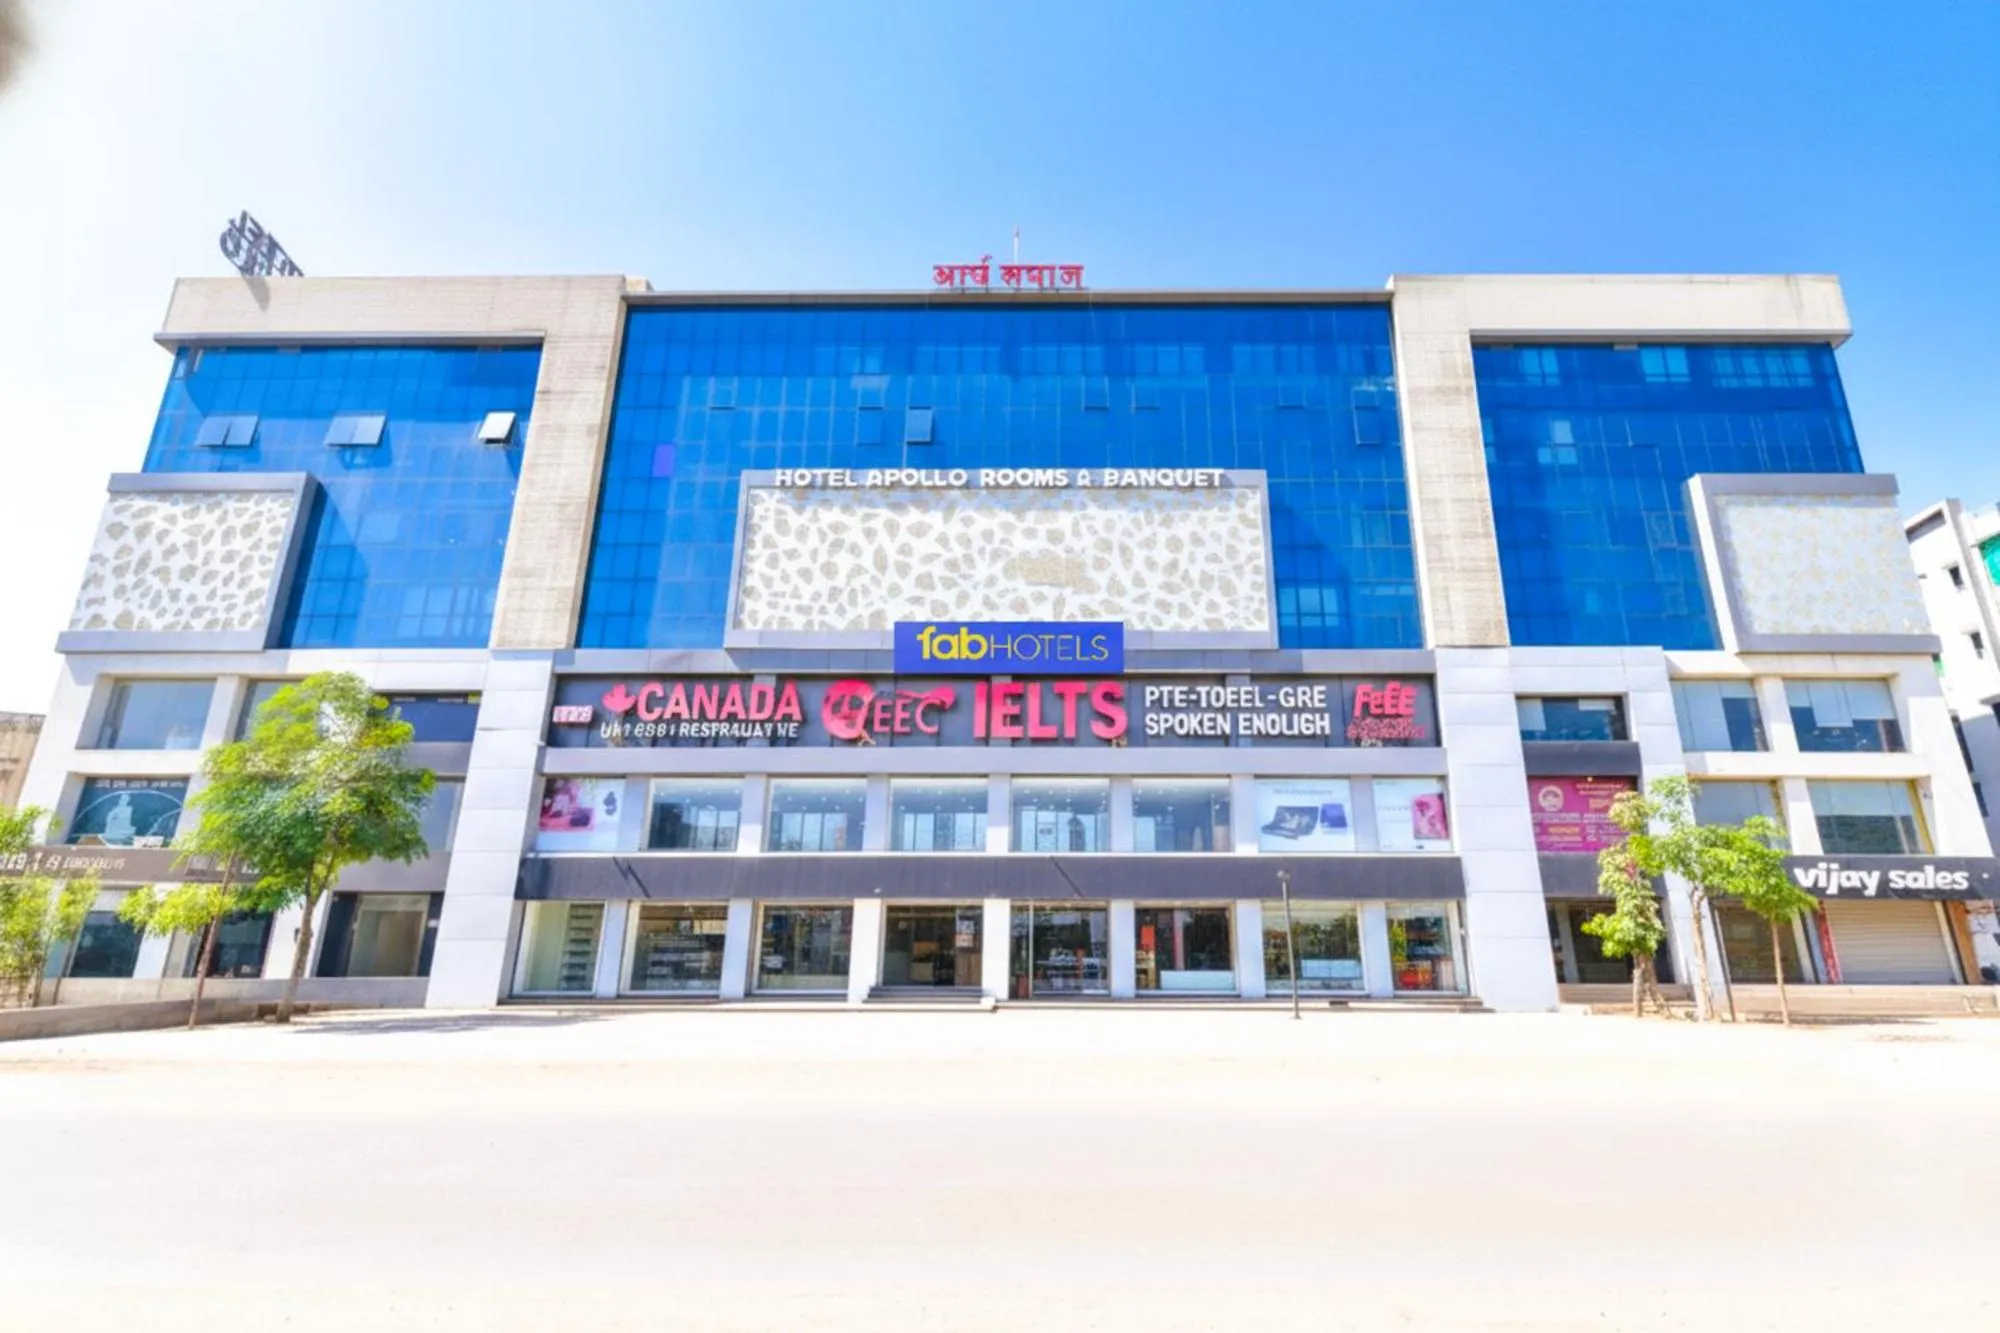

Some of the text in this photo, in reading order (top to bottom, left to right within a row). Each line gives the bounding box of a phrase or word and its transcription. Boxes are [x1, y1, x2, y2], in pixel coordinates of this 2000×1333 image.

[775, 468, 857, 487] HOTEL
[865, 468, 967, 487] APOLLO
[979, 468, 1069, 487] ROOMS
[1104, 468, 1225, 488] BANQUET
[636, 681, 803, 721] CANADA
[973, 681, 1128, 739] IELTS
[1145, 712, 1231, 736] SPOKEN
[1793, 862, 1970, 897] vijay sales
